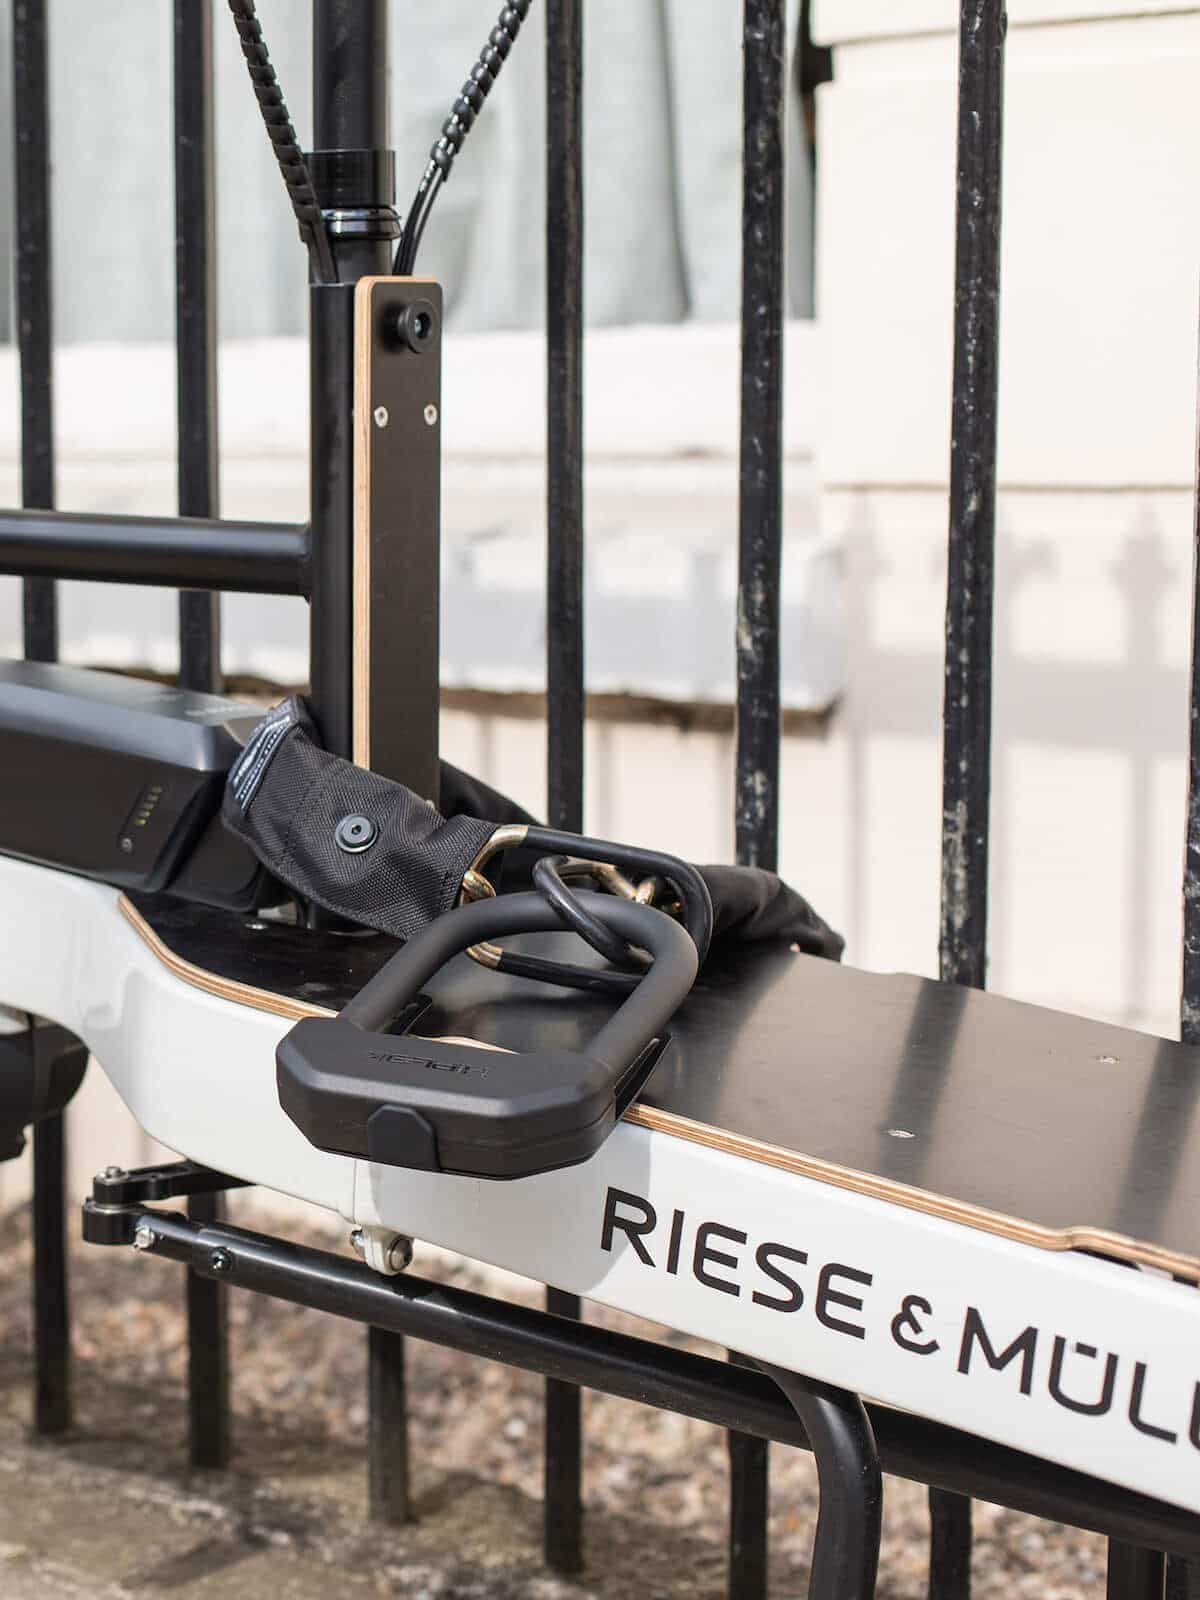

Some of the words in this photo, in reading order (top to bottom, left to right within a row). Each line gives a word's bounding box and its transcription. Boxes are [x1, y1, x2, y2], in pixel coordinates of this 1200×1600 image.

[600, 1186, 873, 1340] RIESE
[890, 1294, 940, 1355] &
[957, 1306, 1200, 1451] MÜL
